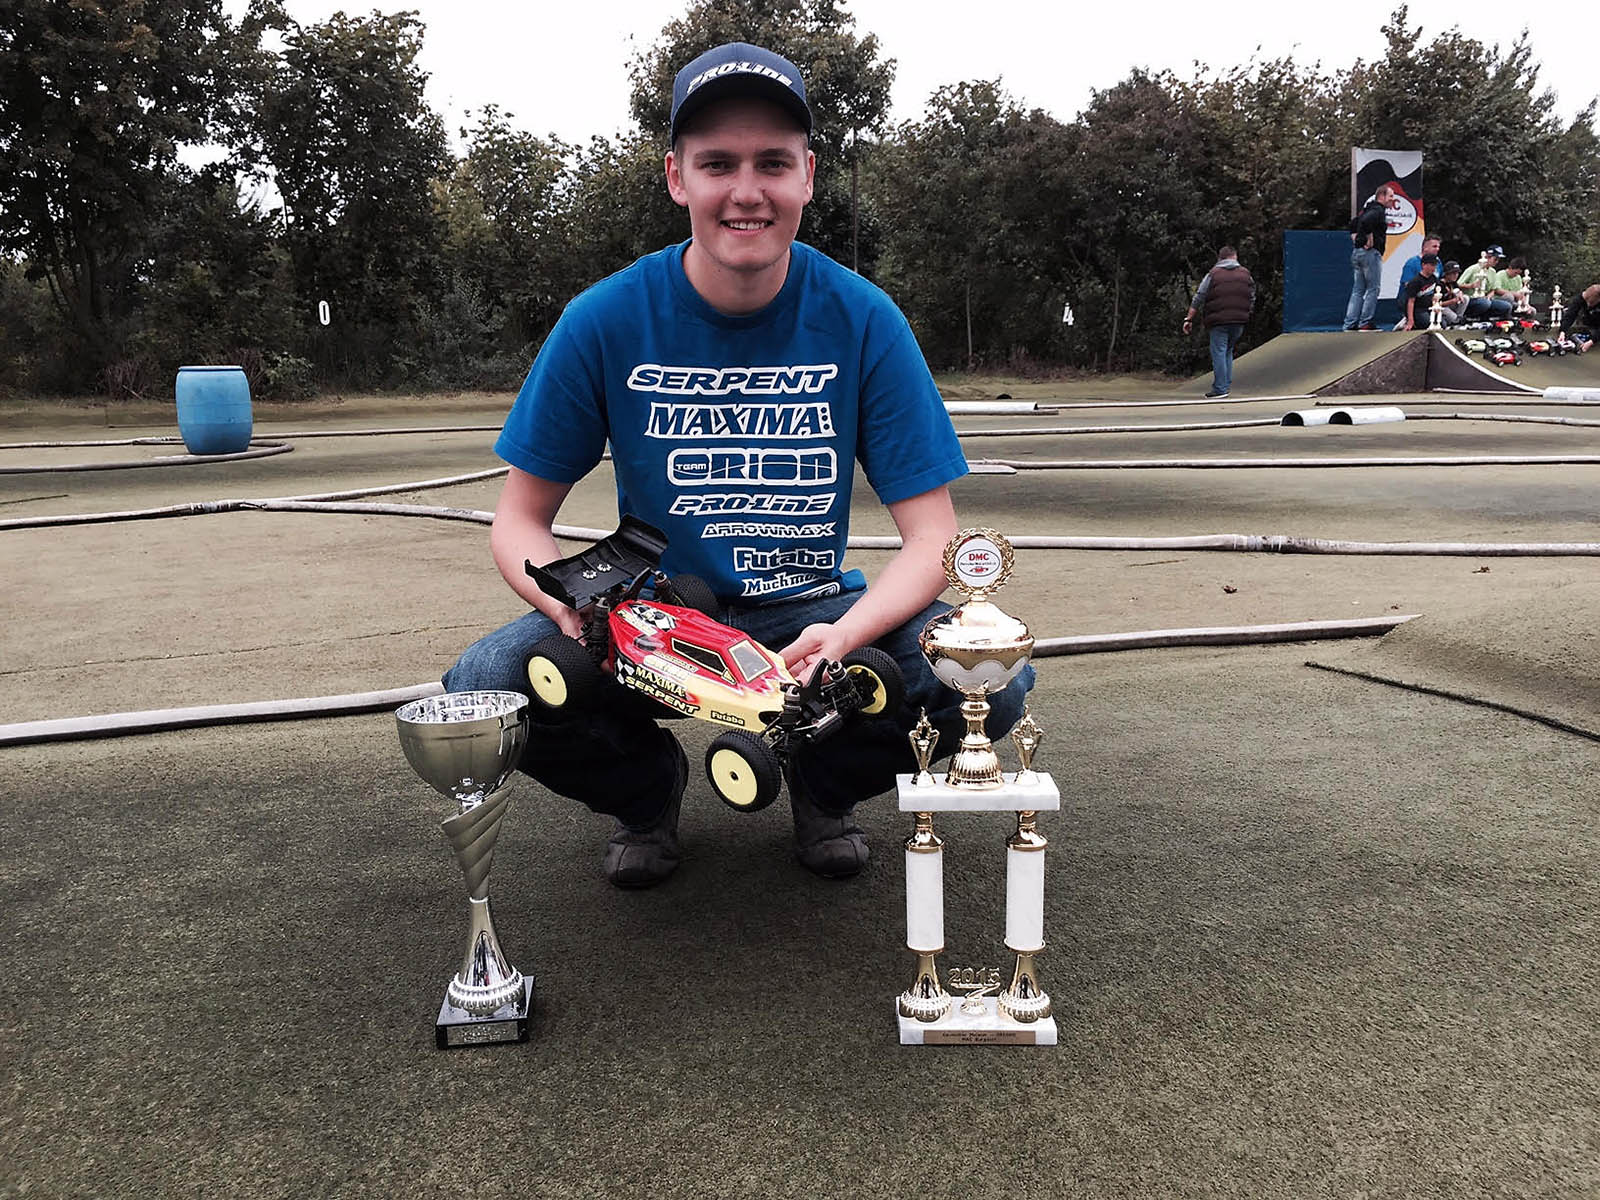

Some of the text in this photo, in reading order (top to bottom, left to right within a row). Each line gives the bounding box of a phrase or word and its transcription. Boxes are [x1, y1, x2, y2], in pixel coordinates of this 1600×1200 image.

[629, 365, 837, 394] SERPENT
[669, 448, 836, 484] TEAM ORION
[702, 523, 836, 538] ARROWMAX
[734, 548, 834, 571] Futaba
[968, 552, 990, 562] DMC
[624, 675, 701, 715] SERPENT
[711, 710, 745, 726] Futaba
[949, 967, 1001, 984] 2015
